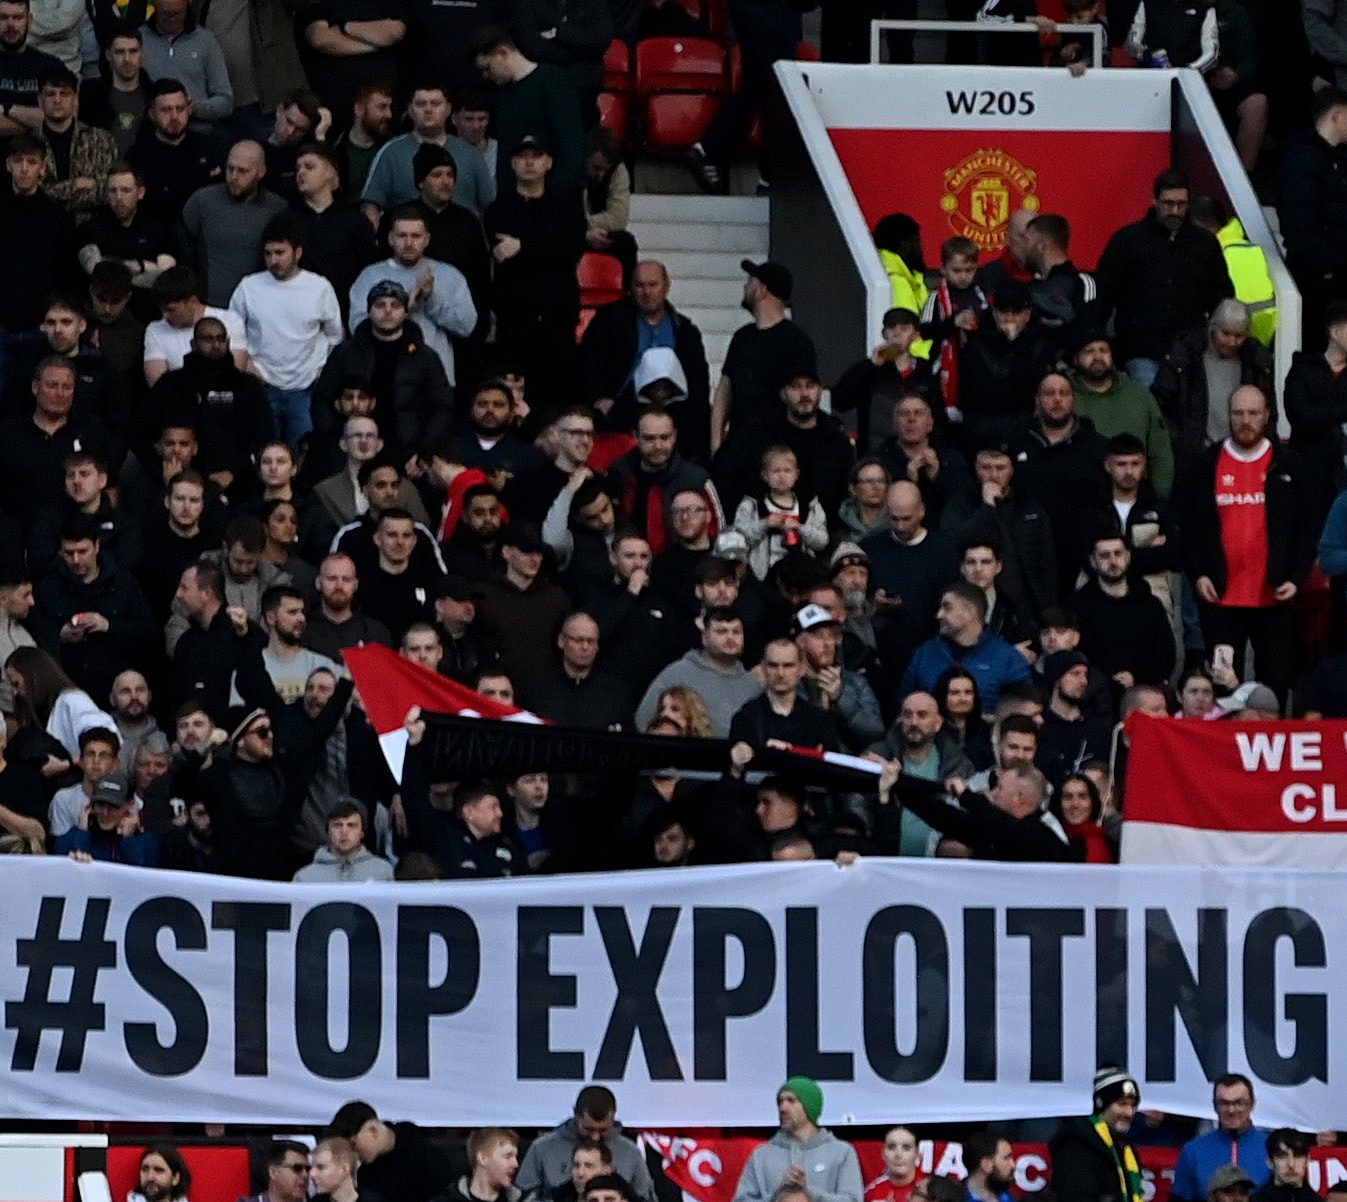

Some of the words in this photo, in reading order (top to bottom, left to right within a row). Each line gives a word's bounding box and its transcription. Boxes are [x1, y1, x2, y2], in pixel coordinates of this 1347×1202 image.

[945, 90, 1035, 116] W205
[1235, 731, 1323, 772] WE
[4, 895, 481, 1081] #STOP
[516, 903, 1329, 1088] EXPLOITING
